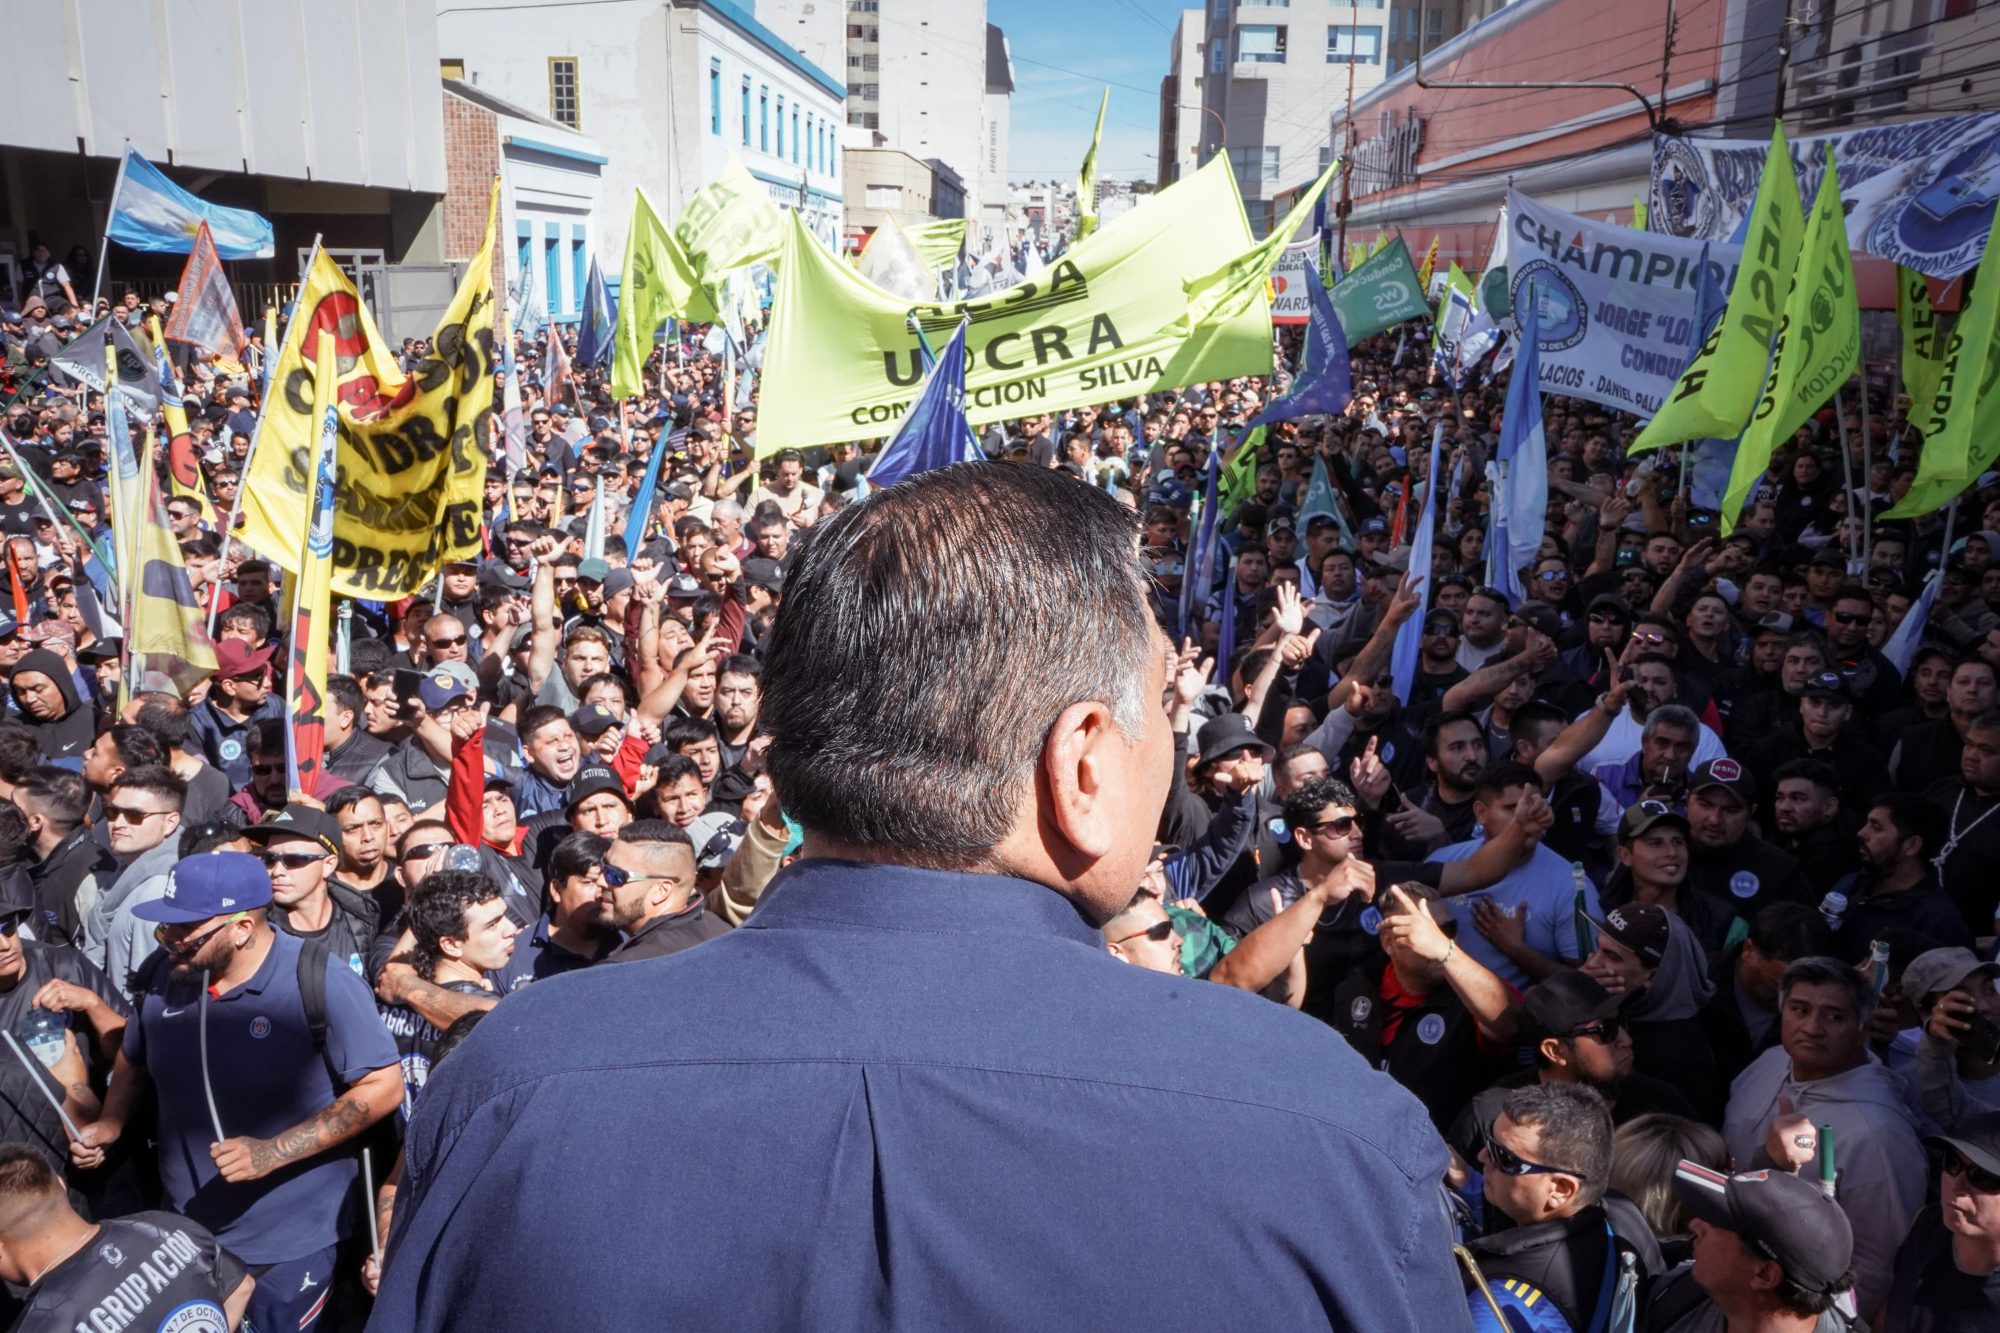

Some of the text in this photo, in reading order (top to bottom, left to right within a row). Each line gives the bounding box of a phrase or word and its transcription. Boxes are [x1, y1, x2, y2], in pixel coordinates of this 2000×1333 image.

[1511, 260, 1547, 295] SINDICATO
[1594, 301, 1652, 339] JORGE
[1909, 280, 1934, 360] AES
[1079, 357, 1165, 392] SILVA
[1538, 362, 1585, 389] LACIOS
[1595, 374, 1634, 404] DANIEL
[582, 767, 611, 780] ACTIVISTA
[180, 1309, 194, 1322] DE
